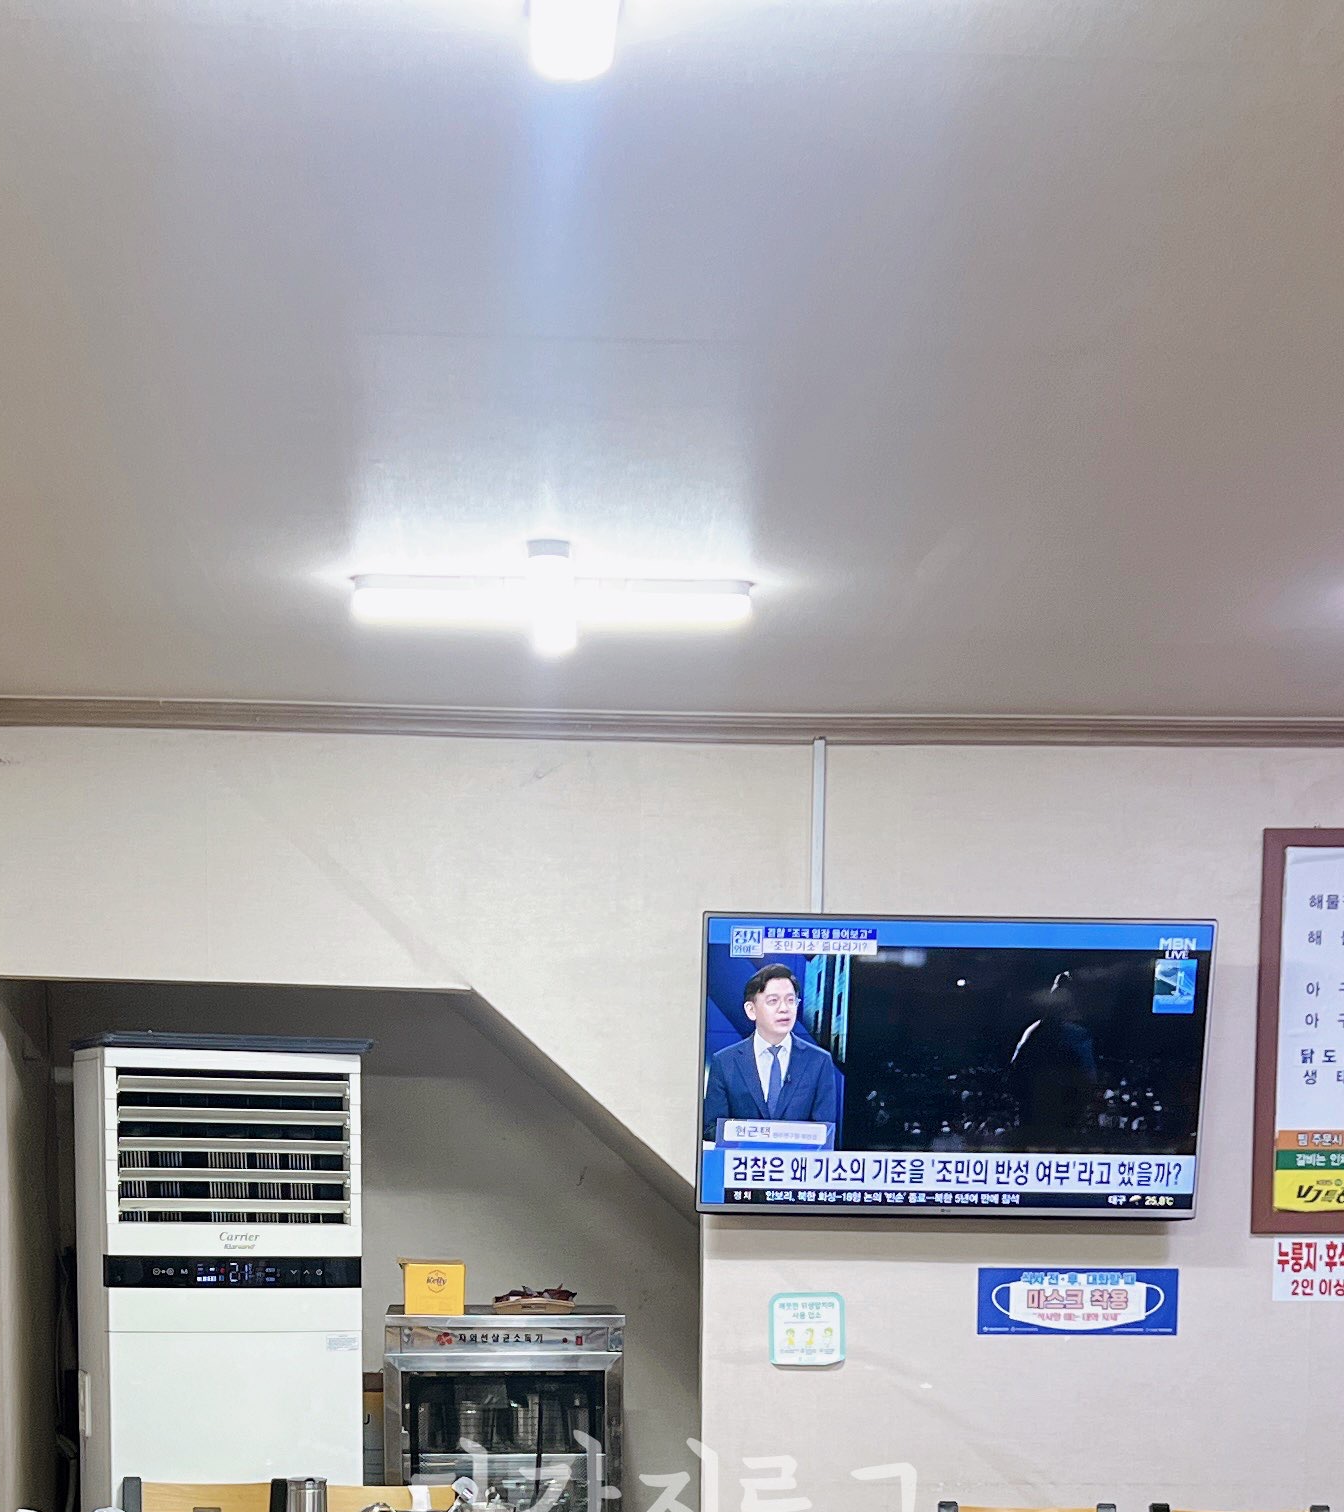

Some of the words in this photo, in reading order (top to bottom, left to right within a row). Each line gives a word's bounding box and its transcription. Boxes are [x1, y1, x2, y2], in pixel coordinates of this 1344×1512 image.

[1159, 937, 1197, 950] MBN
[1165, 950, 1188, 960] LIVE
[736, 1125, 771, 1138] 현근택
[1296, 1153, 1326, 1166] 갈비는
[732, 1156, 785, 1182] 검찰은
[790, 1156, 808, 1183] 왜
[813, 1157, 867, 1184] 기소의
[872, 1158, 926, 1184] 기준을
[995, 1159, 1030, 1187] 반성
[1117, 1160, 1182, 1188] 했을까?
[219, 1231, 260, 1242] Carrier
[1291, 1279, 1314, 1297] 2인
[1027, 1289, 1084, 1310] 마스크
[1090, 1289, 1128, 1310] 착용
